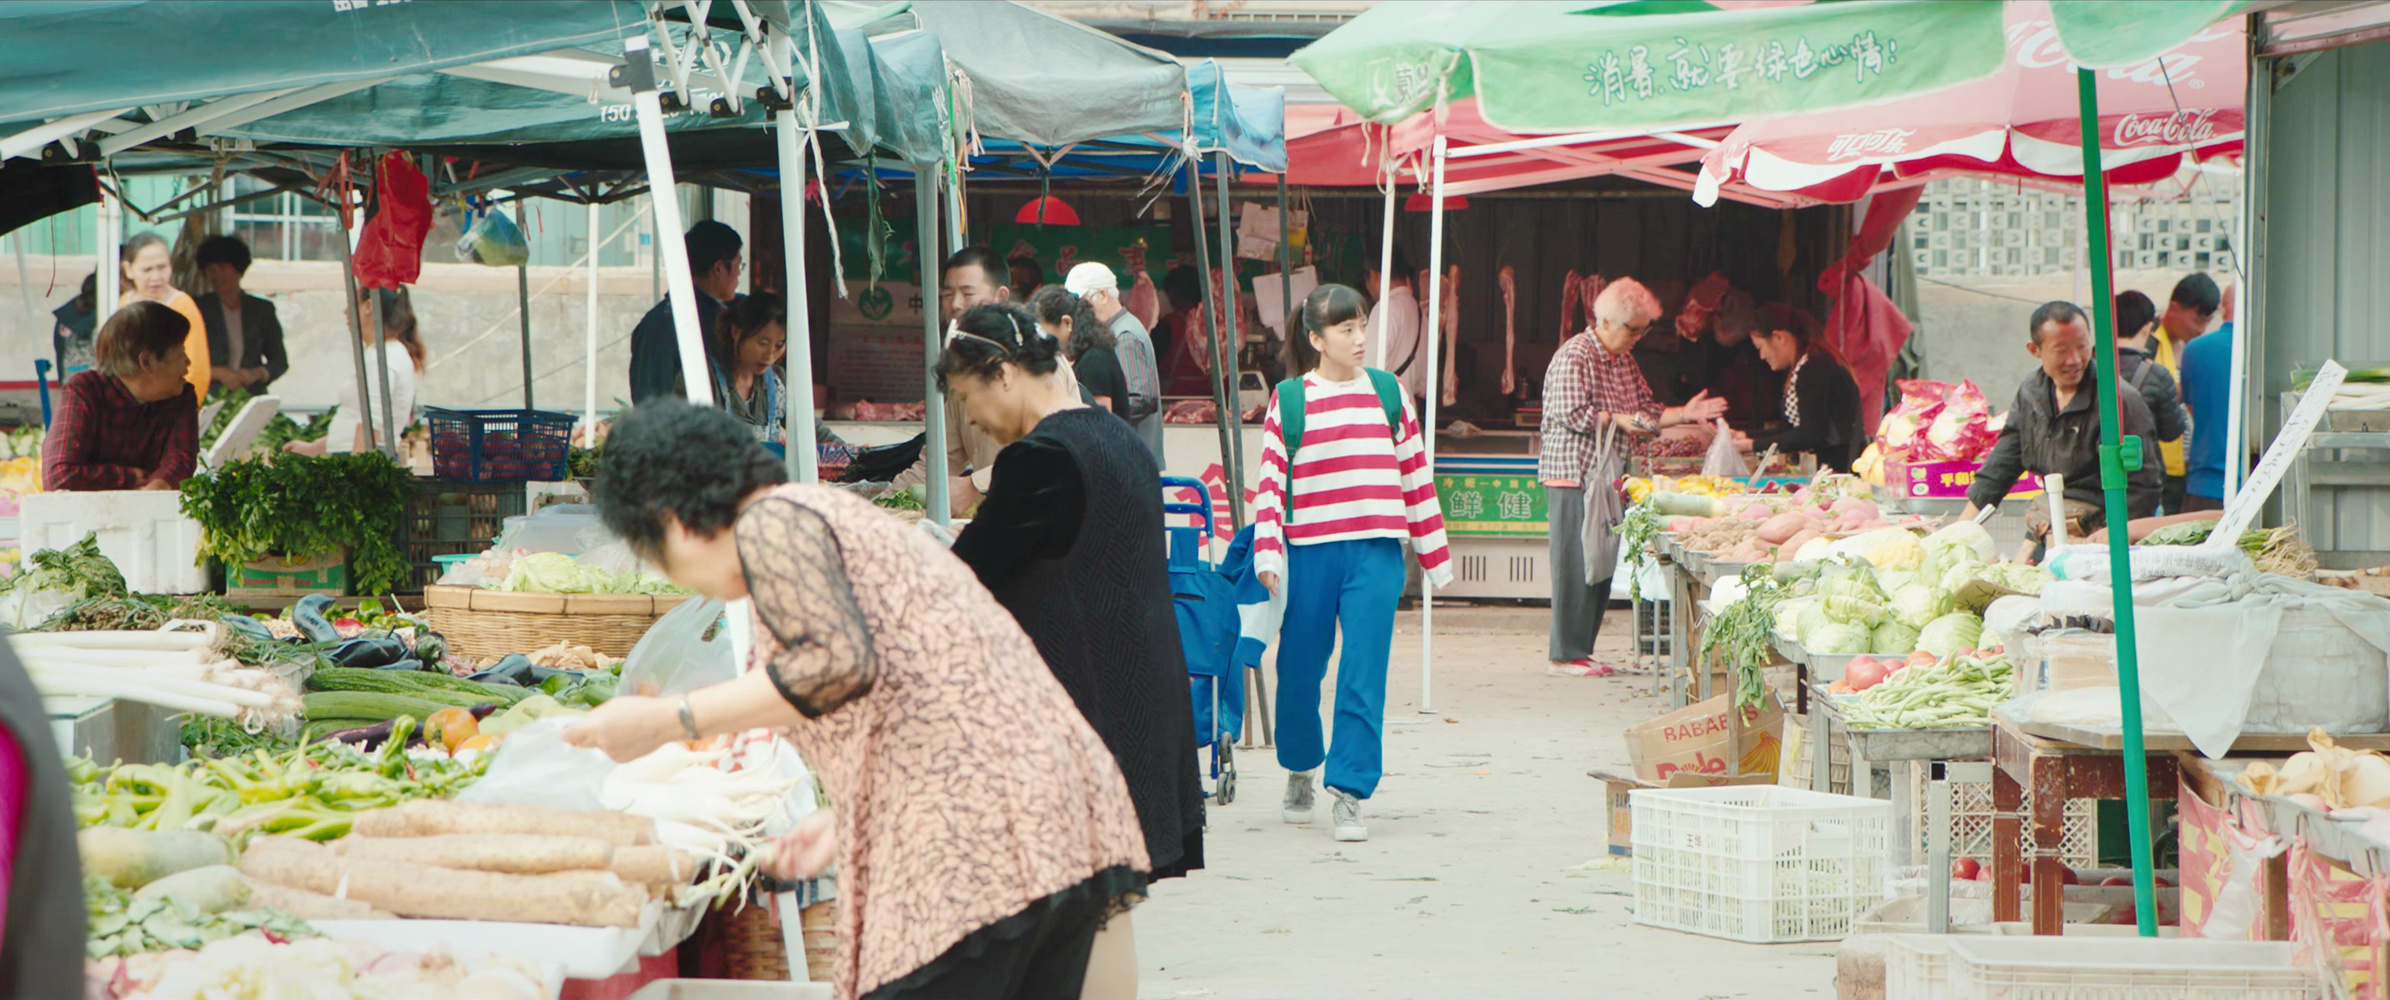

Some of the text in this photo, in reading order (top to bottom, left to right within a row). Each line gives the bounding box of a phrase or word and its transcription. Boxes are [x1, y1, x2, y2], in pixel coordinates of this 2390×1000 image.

[600, 103, 632, 122] 150
[2114, 107, 2220, 147] Coca-Cola
[1826, 127, 1918, 162] 可口可乐
[1664, 704, 1759, 743] BABABS
